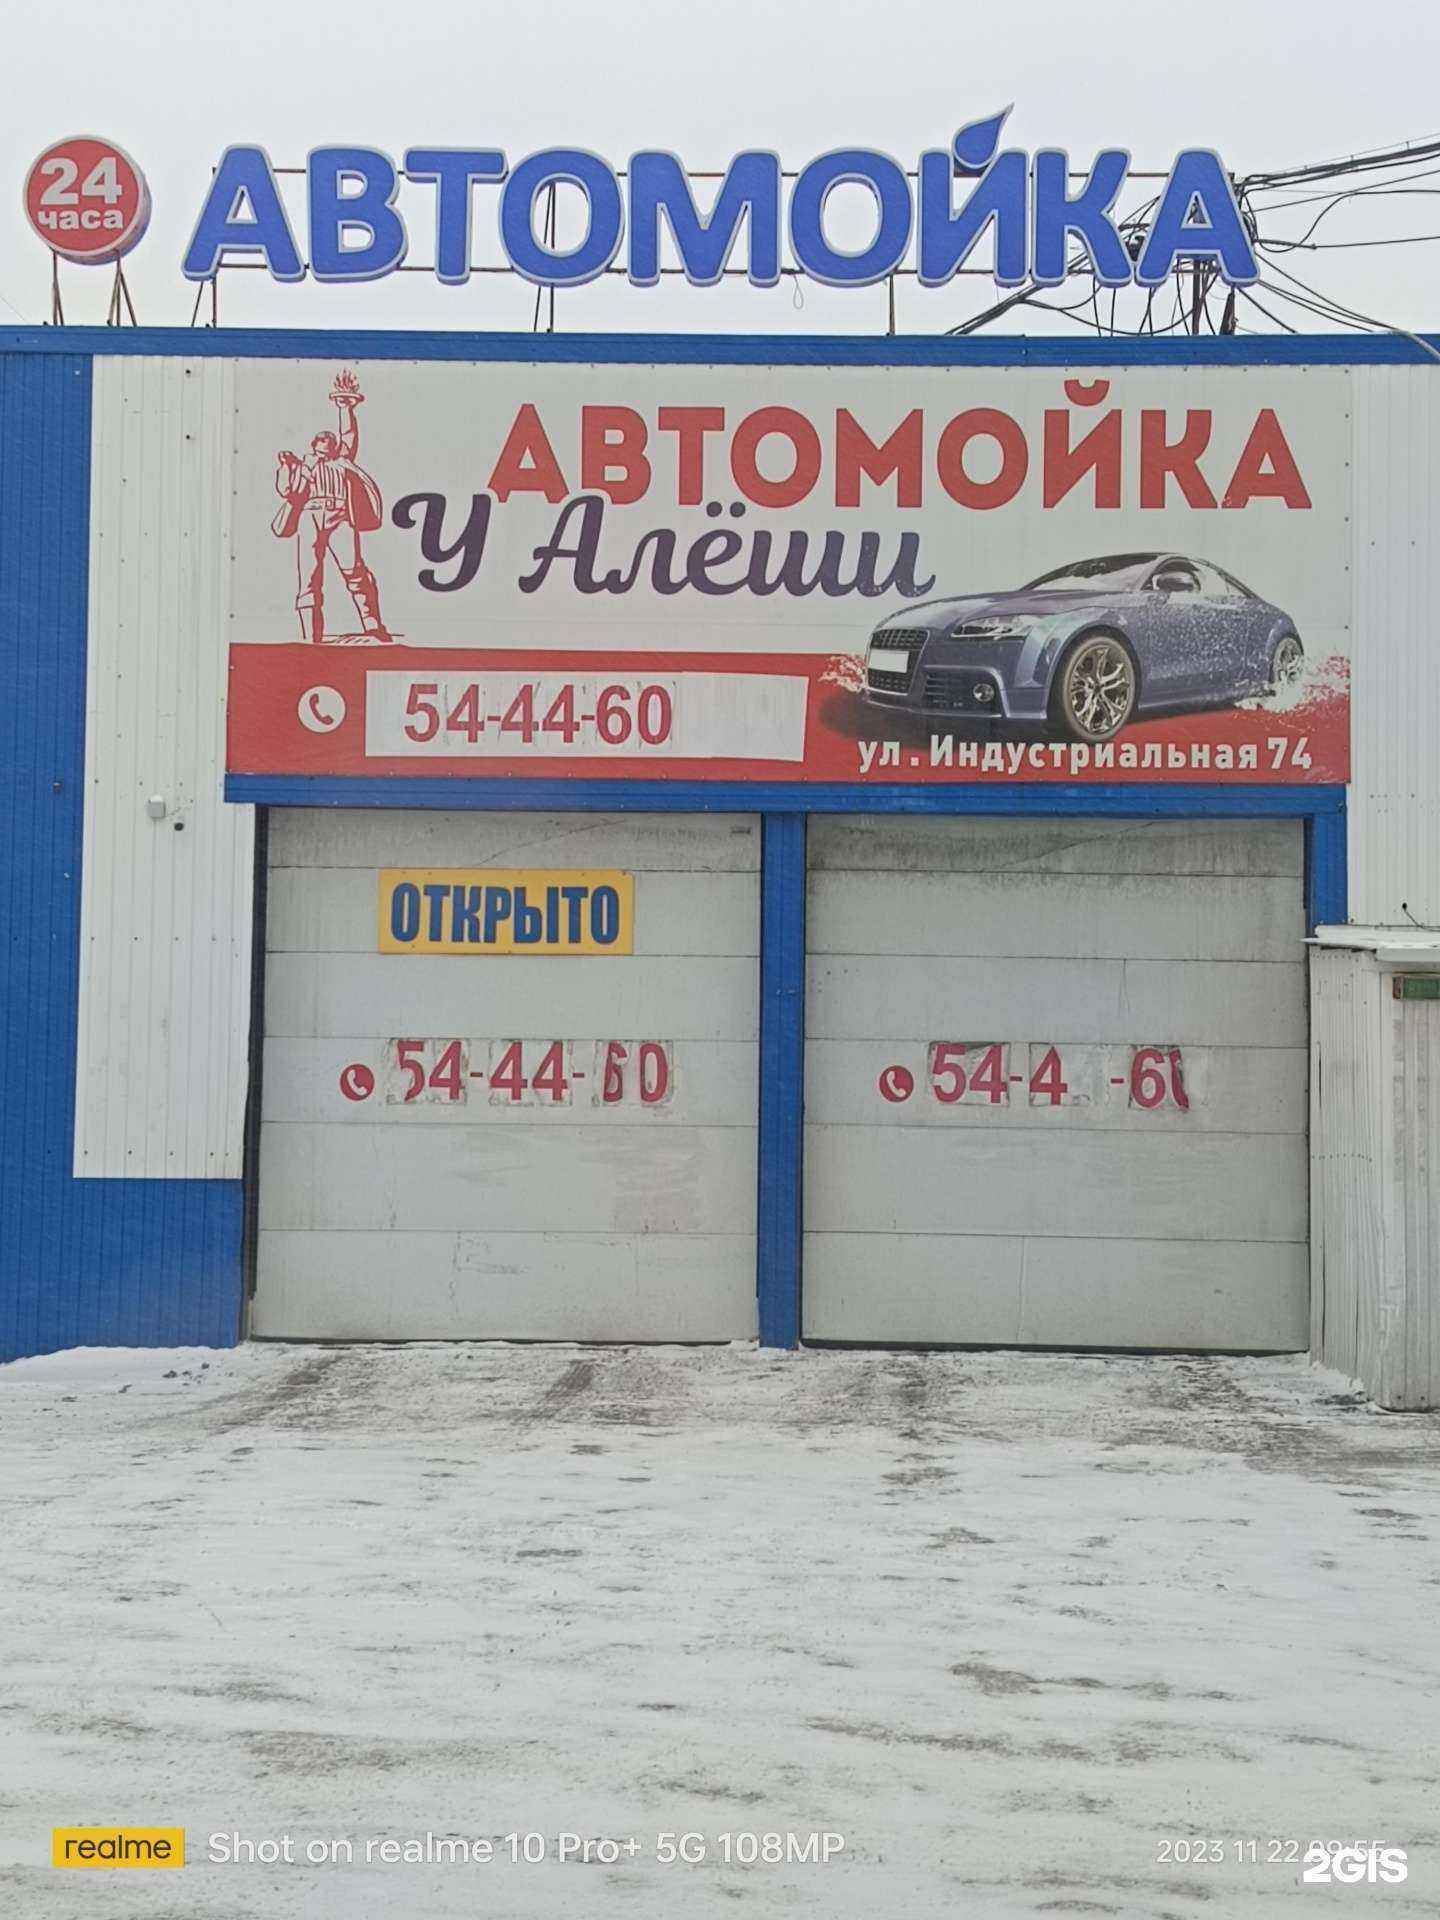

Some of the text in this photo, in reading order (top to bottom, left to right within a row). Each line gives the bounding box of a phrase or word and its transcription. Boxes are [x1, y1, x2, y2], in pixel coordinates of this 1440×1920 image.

[39, 157, 123, 205] 24
[181, 103, 1260, 288] АВТОМОЙКА
[38, 209, 124, 230] часа
[487, 379, 1312, 509] АВТОМОЙКА
[518, 494, 936, 597] Алёши
[404, 683, 673, 745] 54-44-60
[930, 735, 1258, 775] Индустриальная
[1267, 737, 1312, 769] 74
[390, 883, 620, 944] ОТКРЫТО
